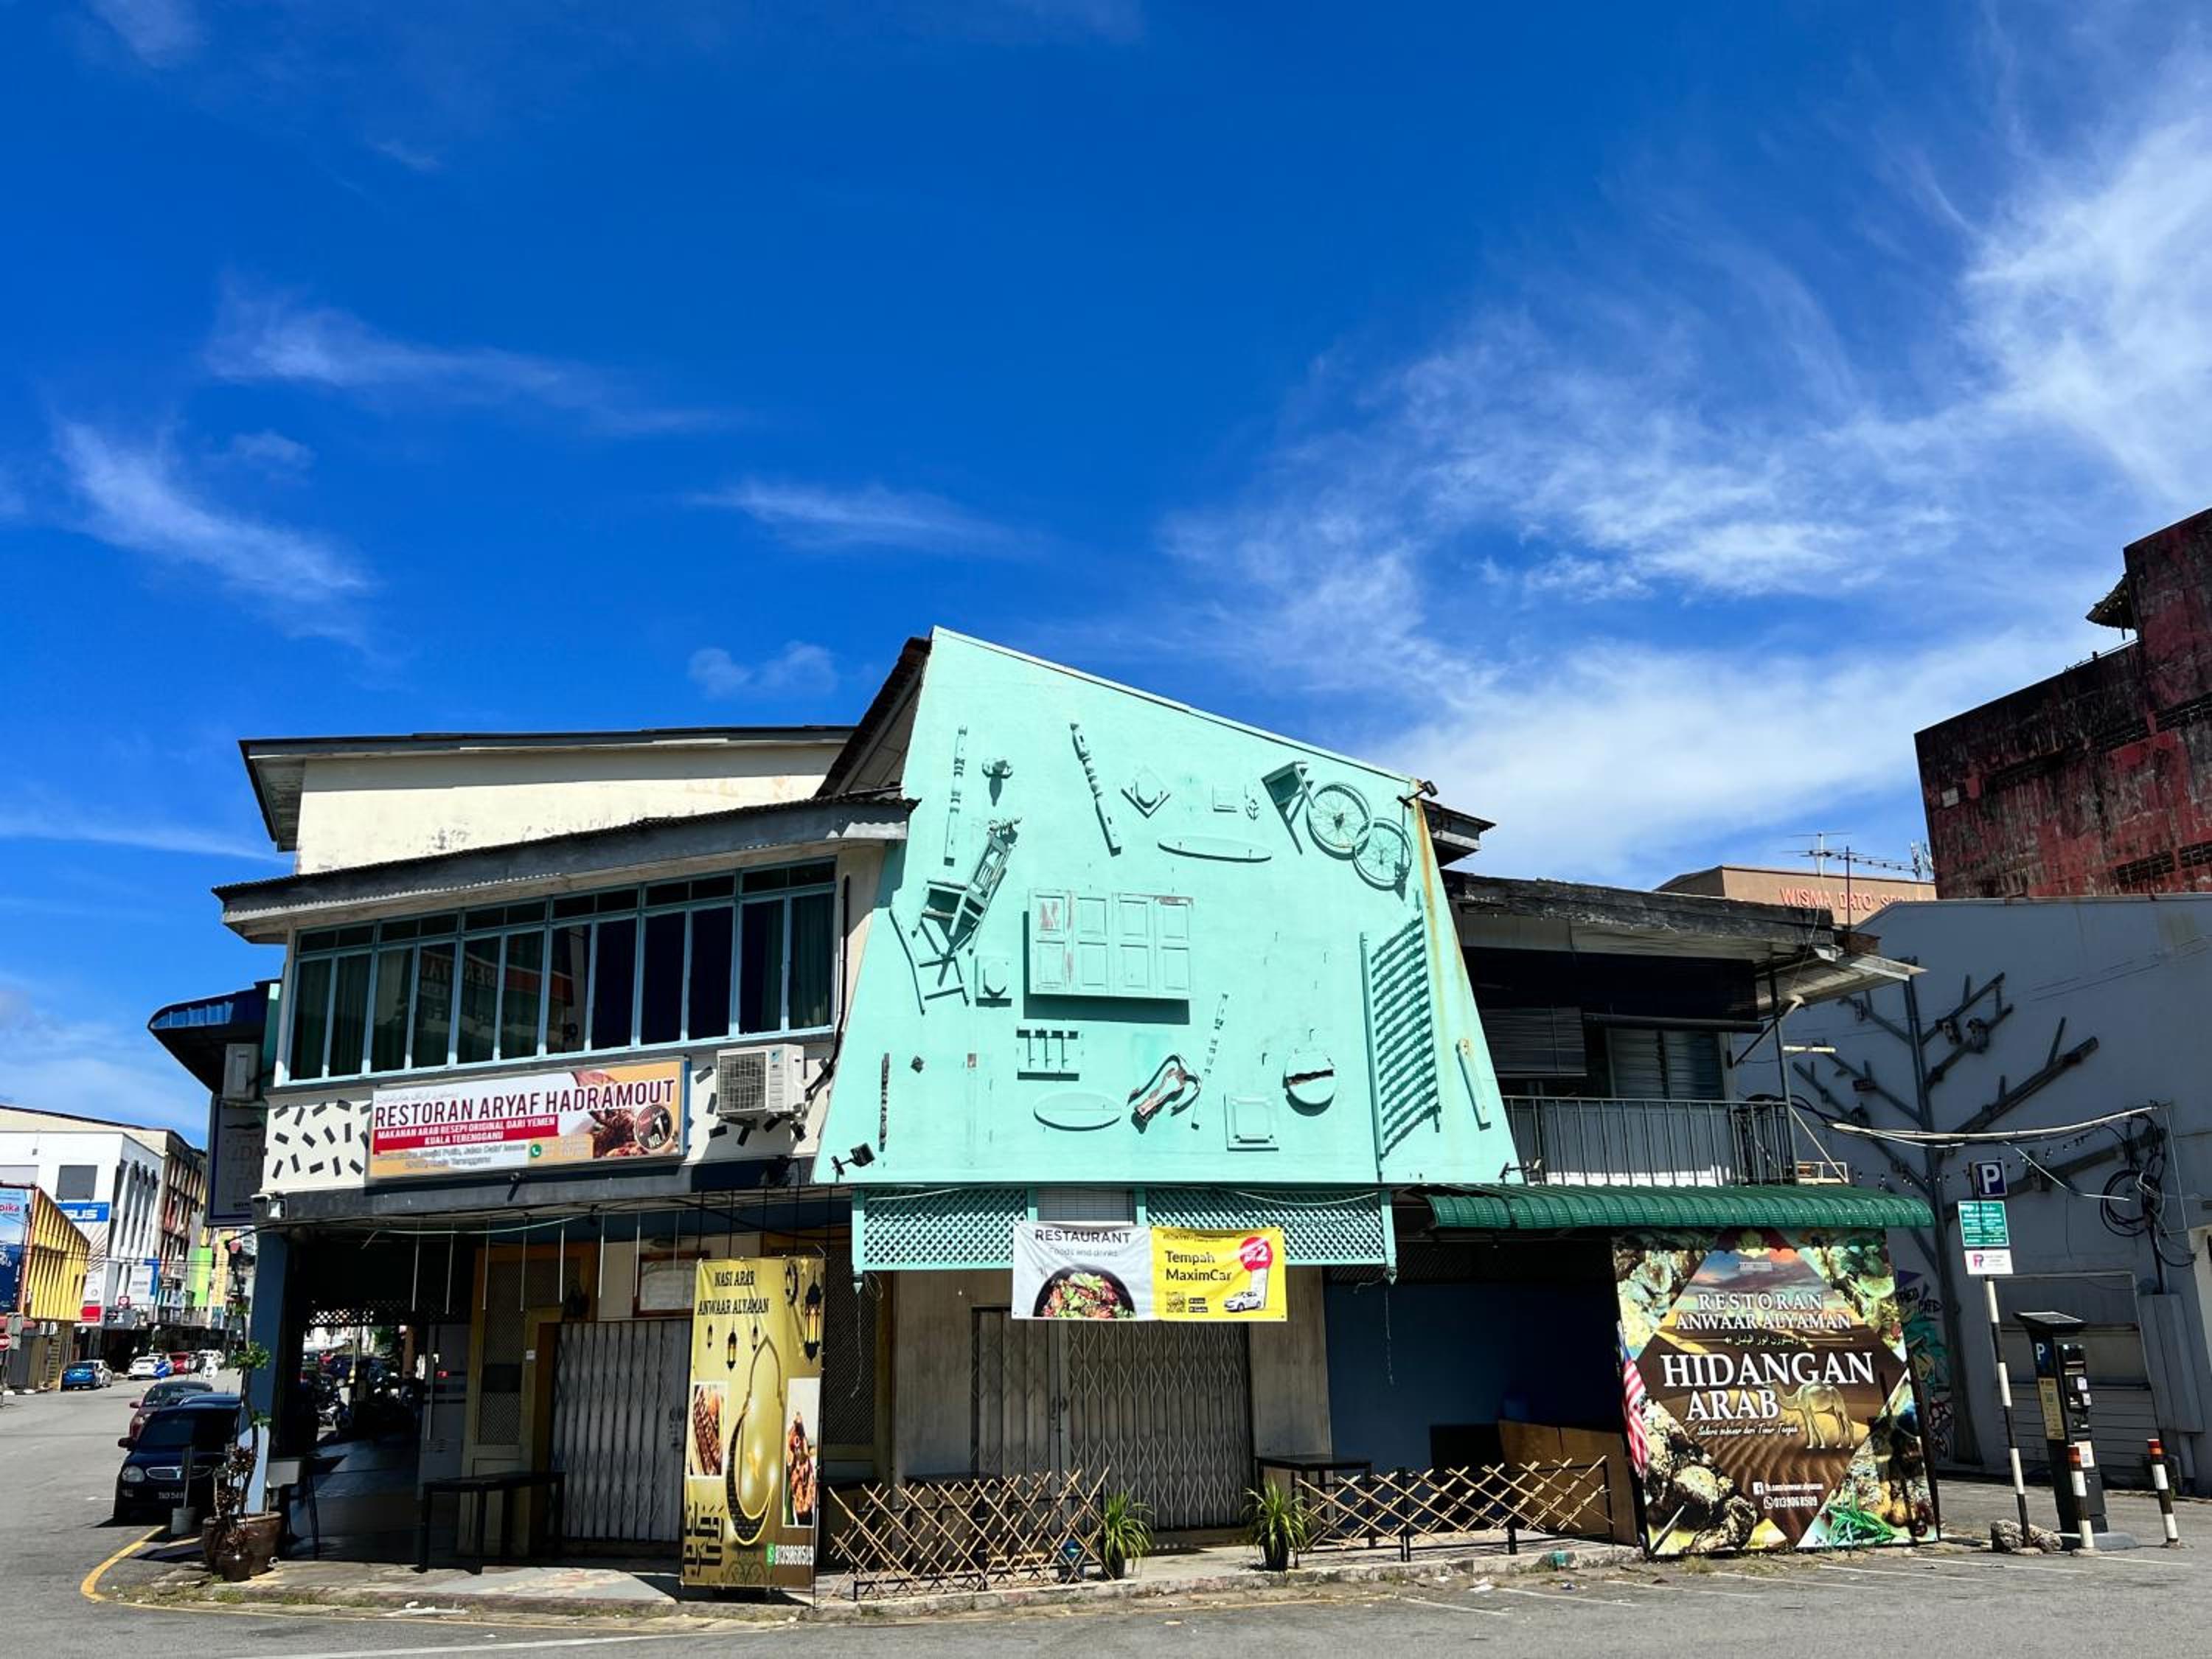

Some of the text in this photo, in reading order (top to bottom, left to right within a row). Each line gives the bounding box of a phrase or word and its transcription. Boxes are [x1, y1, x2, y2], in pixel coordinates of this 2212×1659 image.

[1781, 888, 1832, 908] WISMA
[375, 1099, 473, 1127] RESTORAN
[479, 1093, 540, 1119] ARYAF
[546, 1079, 675, 1113] HADRAMOUT
[378, 1116, 555, 1140] MAKANAN ARAB RESEPI ORIGINAL DARI YEMEN
[425, 1131, 504, 1145] KUALA TERENGGANU
[1981, 1164, 2000, 1194] P
[1035, 1229, 1131, 1244] RESTAURANT
[1165, 1250, 1215, 1265] Tempah
[715, 1270, 754, 1287] NASI ARAB
[1166, 1268, 1232, 1281] MaximCar
[698, 1299, 731, 1315] ANWAAR
[1699, 1294, 1823, 1310] RESTORAN
[1676, 1314, 1851, 1329] ANWAAR ALYAMAN
[1660, 1352, 1875, 1387] HIDANGAN
[1686, 1389, 1779, 1420] ARAB
